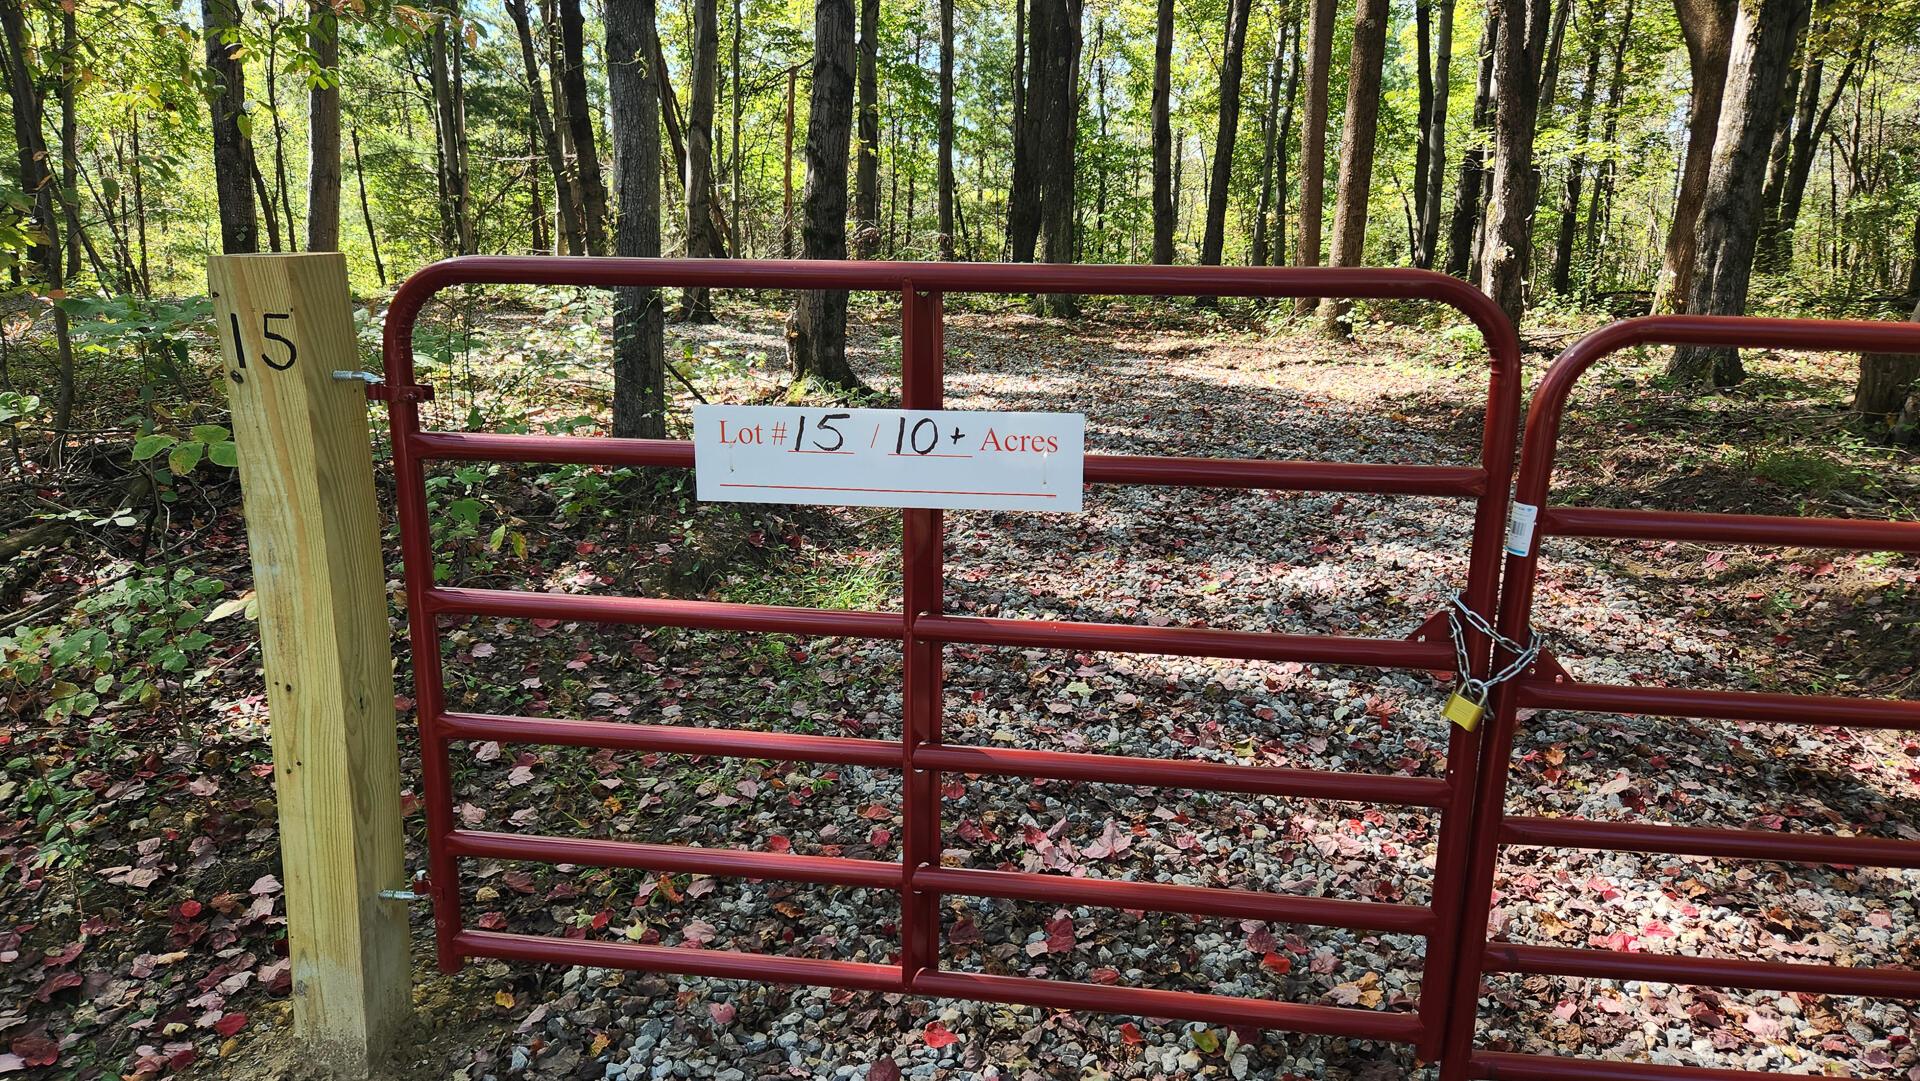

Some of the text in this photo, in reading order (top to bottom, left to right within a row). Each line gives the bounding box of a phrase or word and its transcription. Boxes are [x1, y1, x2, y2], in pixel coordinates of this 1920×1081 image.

[230, 313, 297, 371] 15
[719, 420, 763, 445] Lot
[980, 427, 1059, 453] Acres
